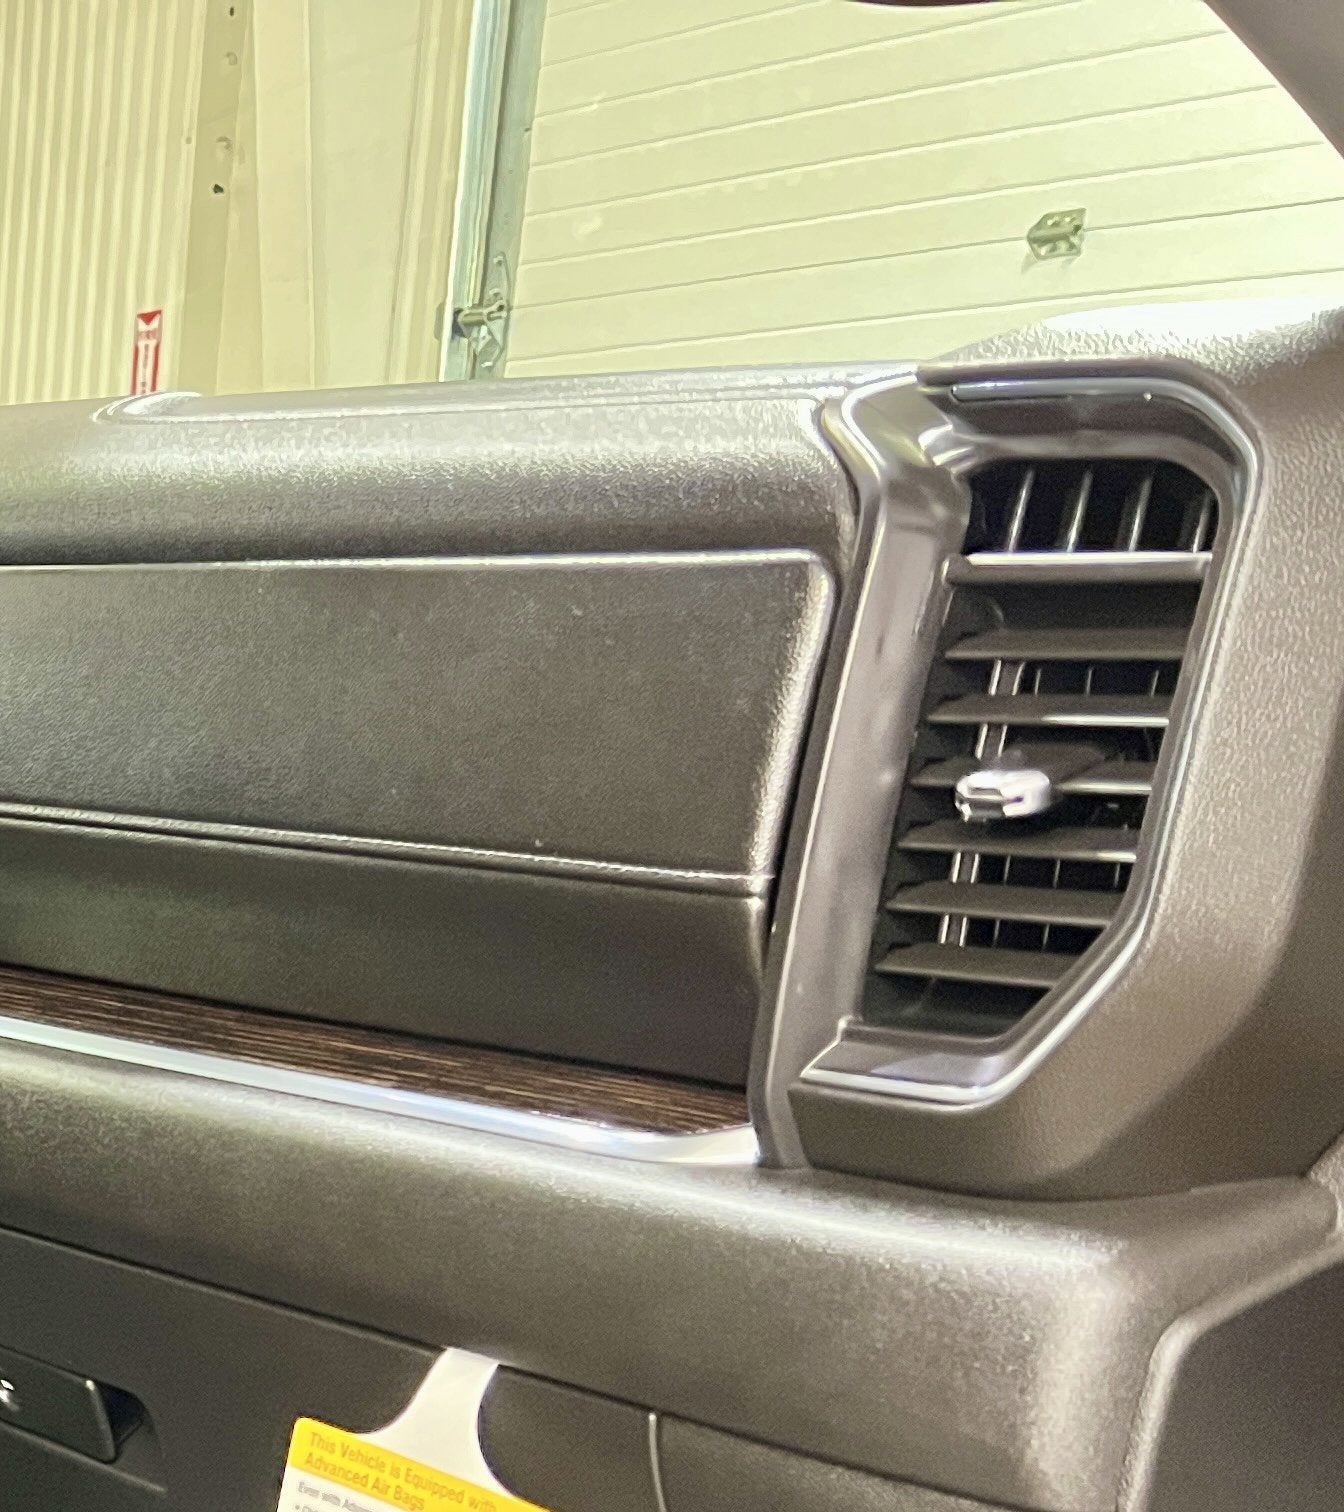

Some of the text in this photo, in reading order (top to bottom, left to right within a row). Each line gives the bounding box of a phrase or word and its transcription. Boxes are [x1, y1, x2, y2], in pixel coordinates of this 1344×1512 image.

[304, 1452, 369, 1488] Advanced
[371, 1476, 391, 1494] Air
[393, 1485, 425, 1512] Bags
[310, 1431, 337, 1454] This
[340, 1441, 387, 1473] Vehicle
[389, 1461, 401, 1480] is
[404, 1467, 465, 1504] Equipped
